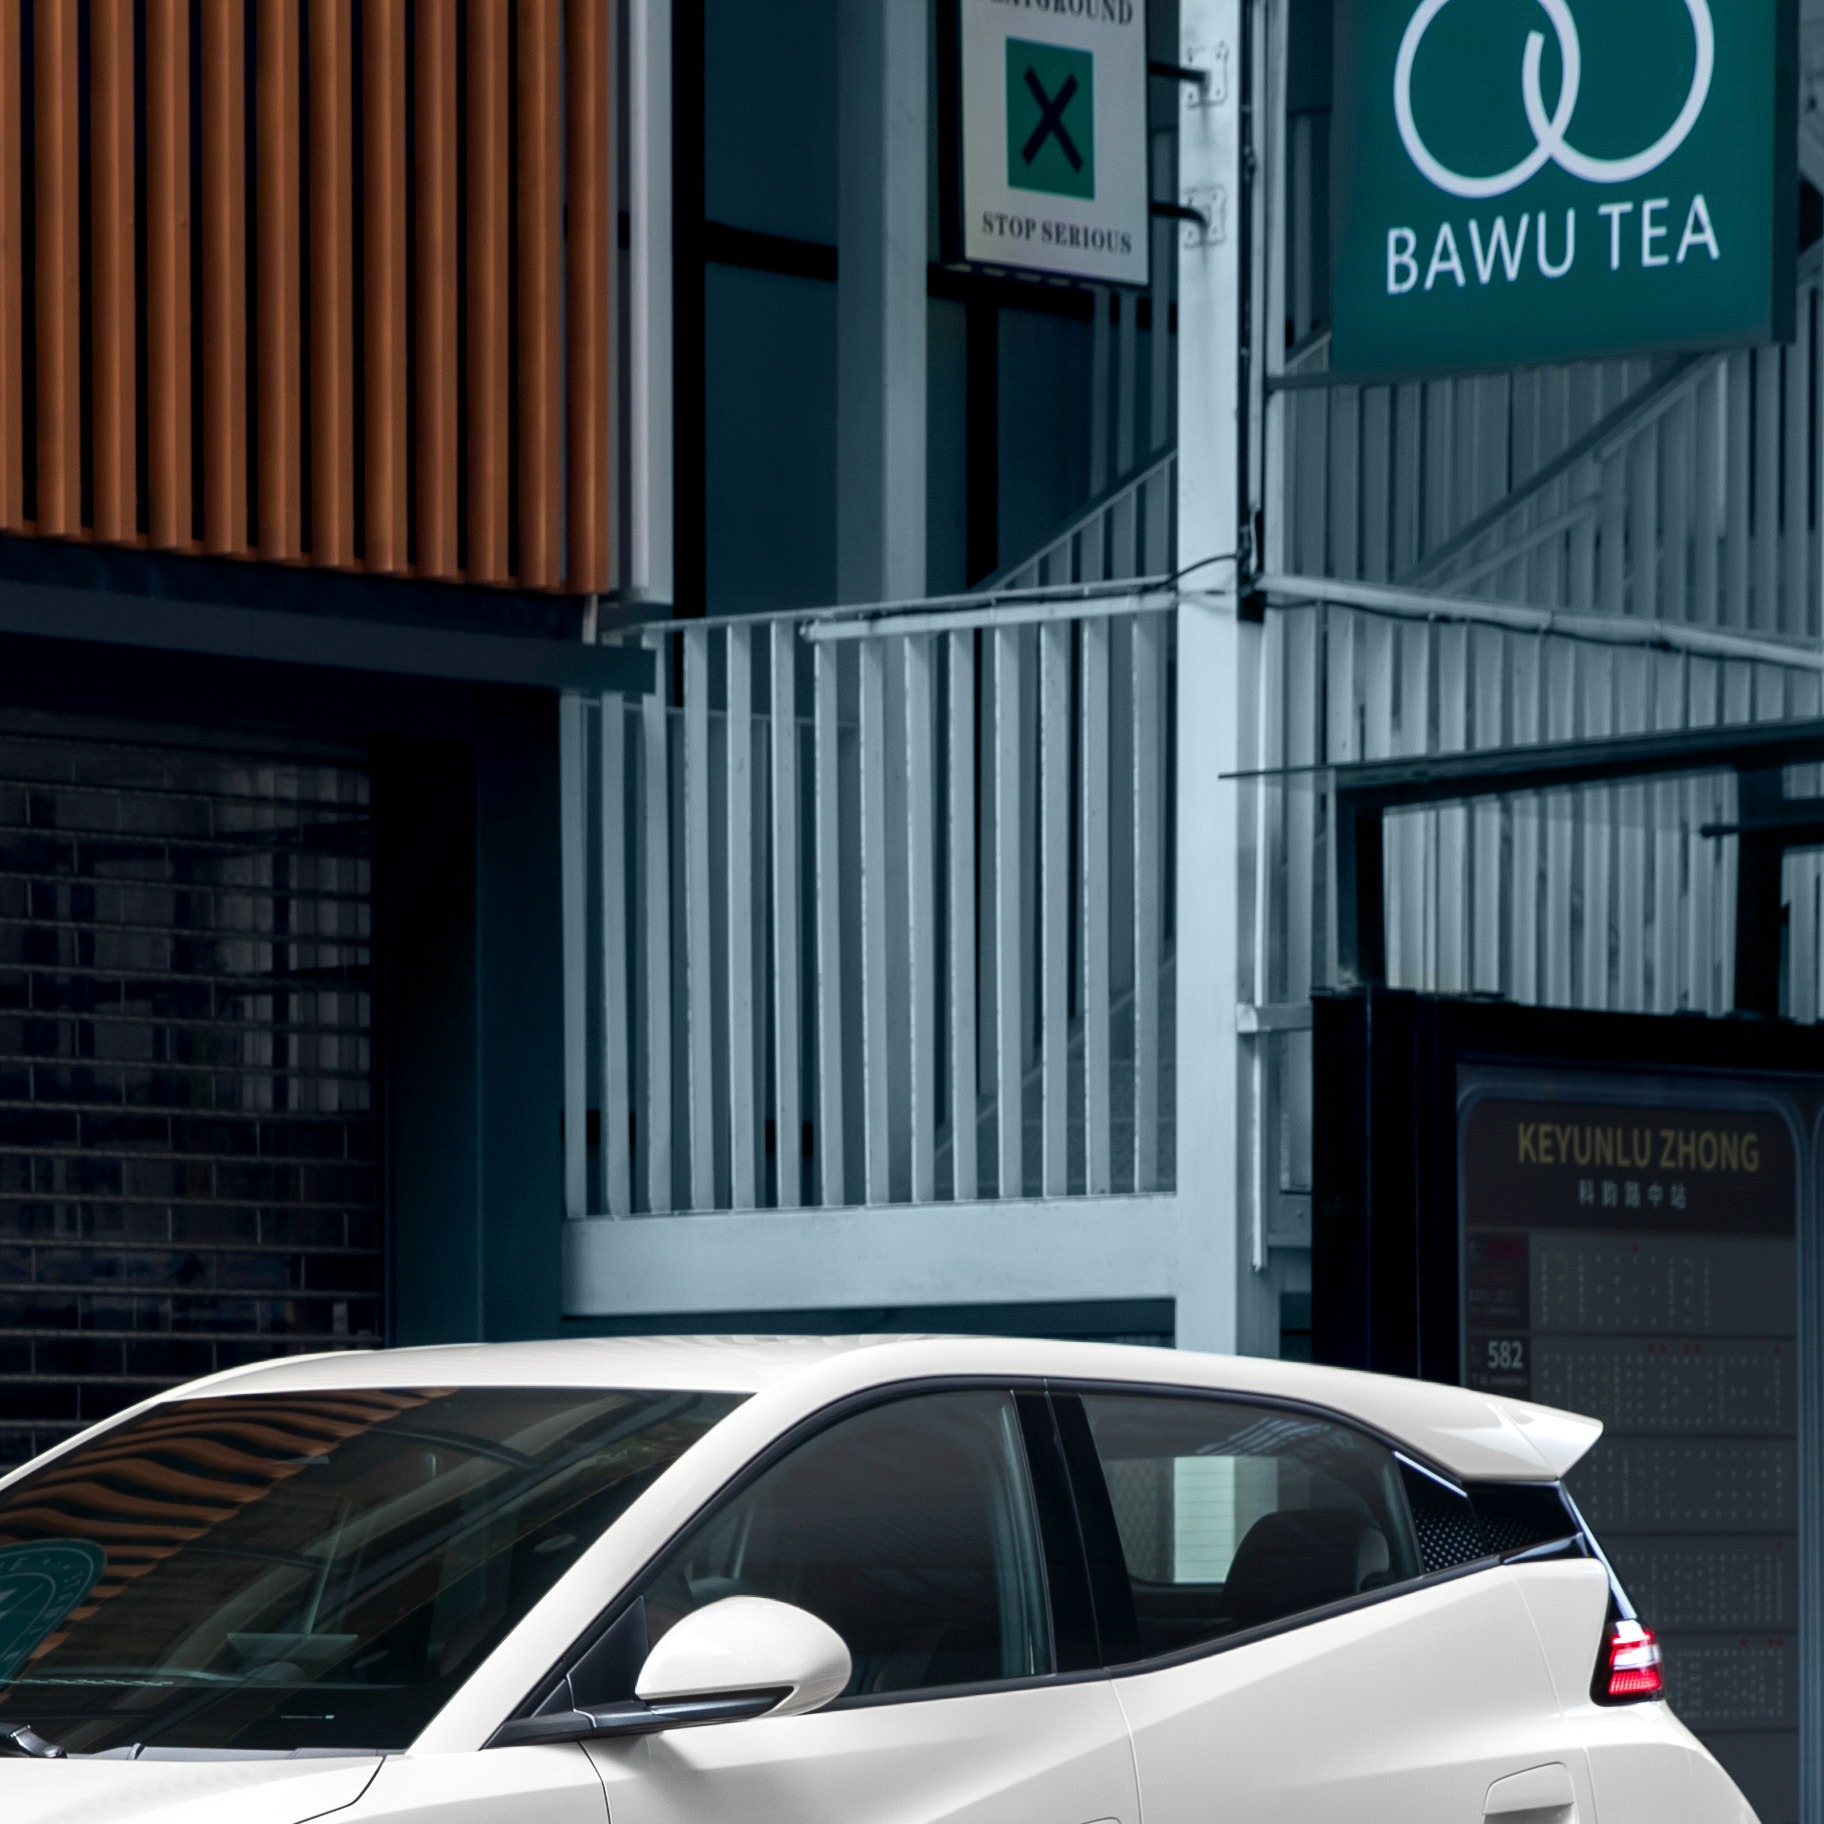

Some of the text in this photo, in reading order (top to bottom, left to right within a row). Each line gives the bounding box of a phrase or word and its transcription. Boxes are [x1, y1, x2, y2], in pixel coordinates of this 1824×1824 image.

[982, 212, 1132, 254] STOP SERIOUS
[1385, 194, 1720, 296] BAWU TEA
[1517, 1122, 1760, 1173] KEYUNLU ZHONG
[1487, 1340, 1524, 1370] 582
